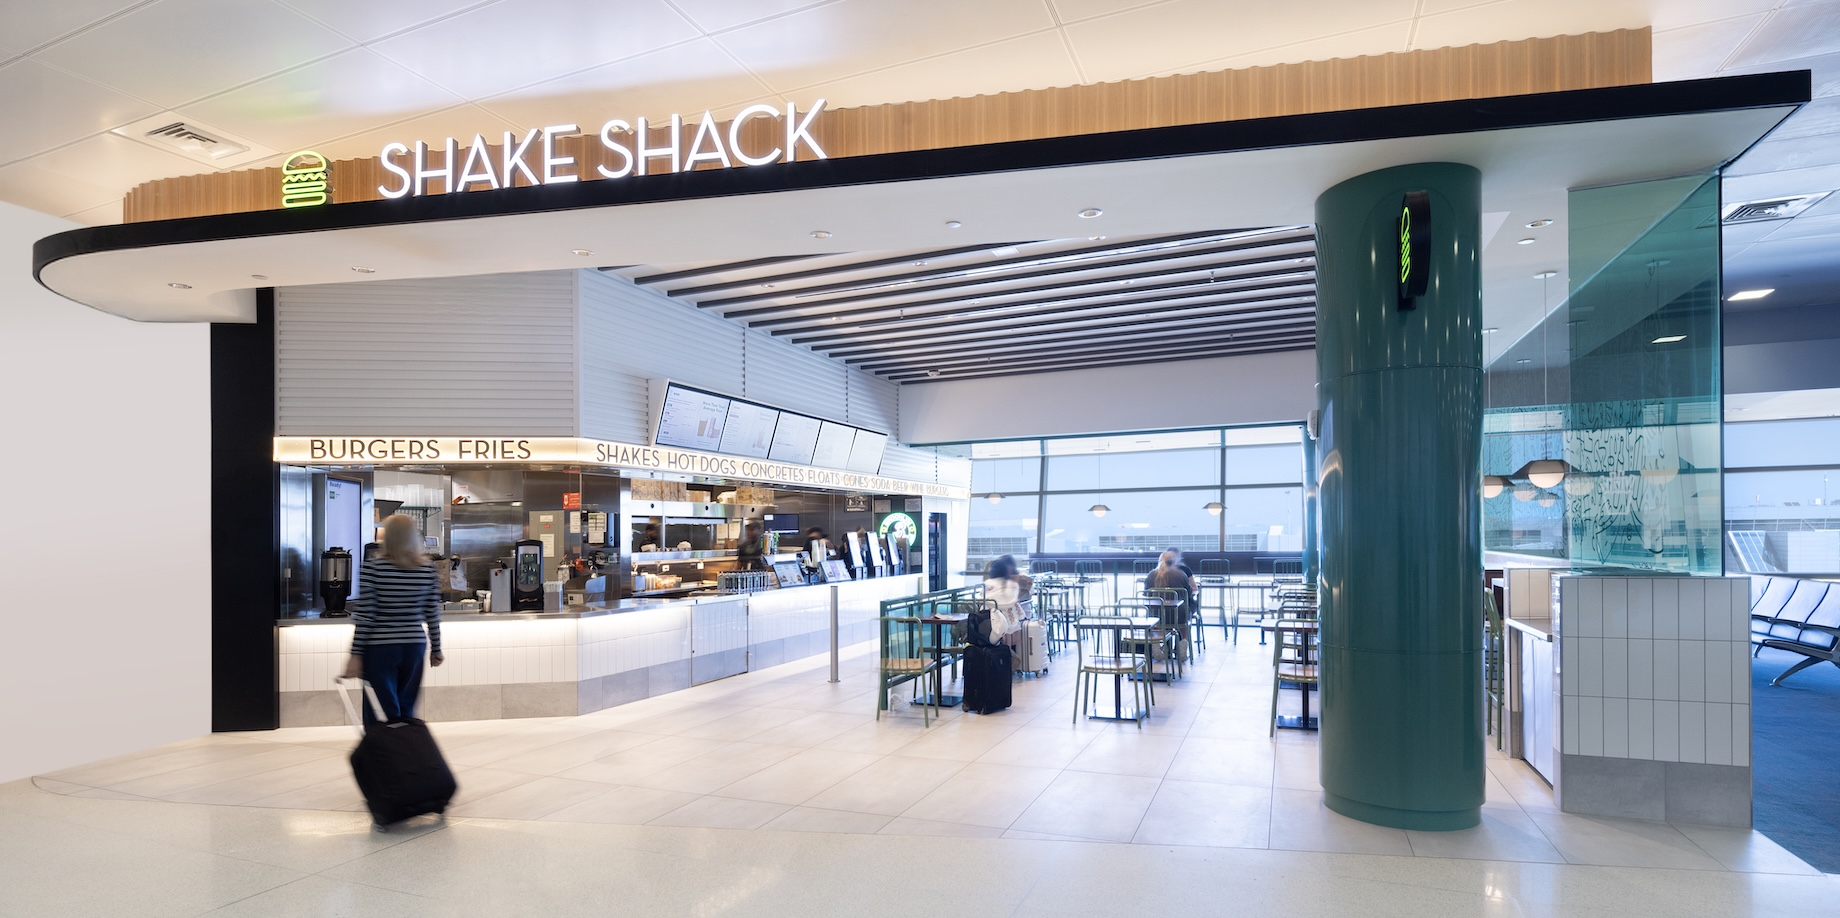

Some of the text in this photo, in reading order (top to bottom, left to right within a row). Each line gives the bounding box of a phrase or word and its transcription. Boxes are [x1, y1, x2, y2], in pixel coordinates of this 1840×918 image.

[377, 98, 829, 200] SHAKE SHACK
[310, 439, 531, 460] BURGERS FRIES
[596, 443, 660, 468] SHAKES
[667, 452, 697, 471] HOT
[700, 456, 737, 476] DOGS
[741, 461, 805, 483] CONCRETES
[808, 470, 840, 487] FLOATS
[843, 474, 869, 489] CONES
[871, 478, 890, 491] SODA
